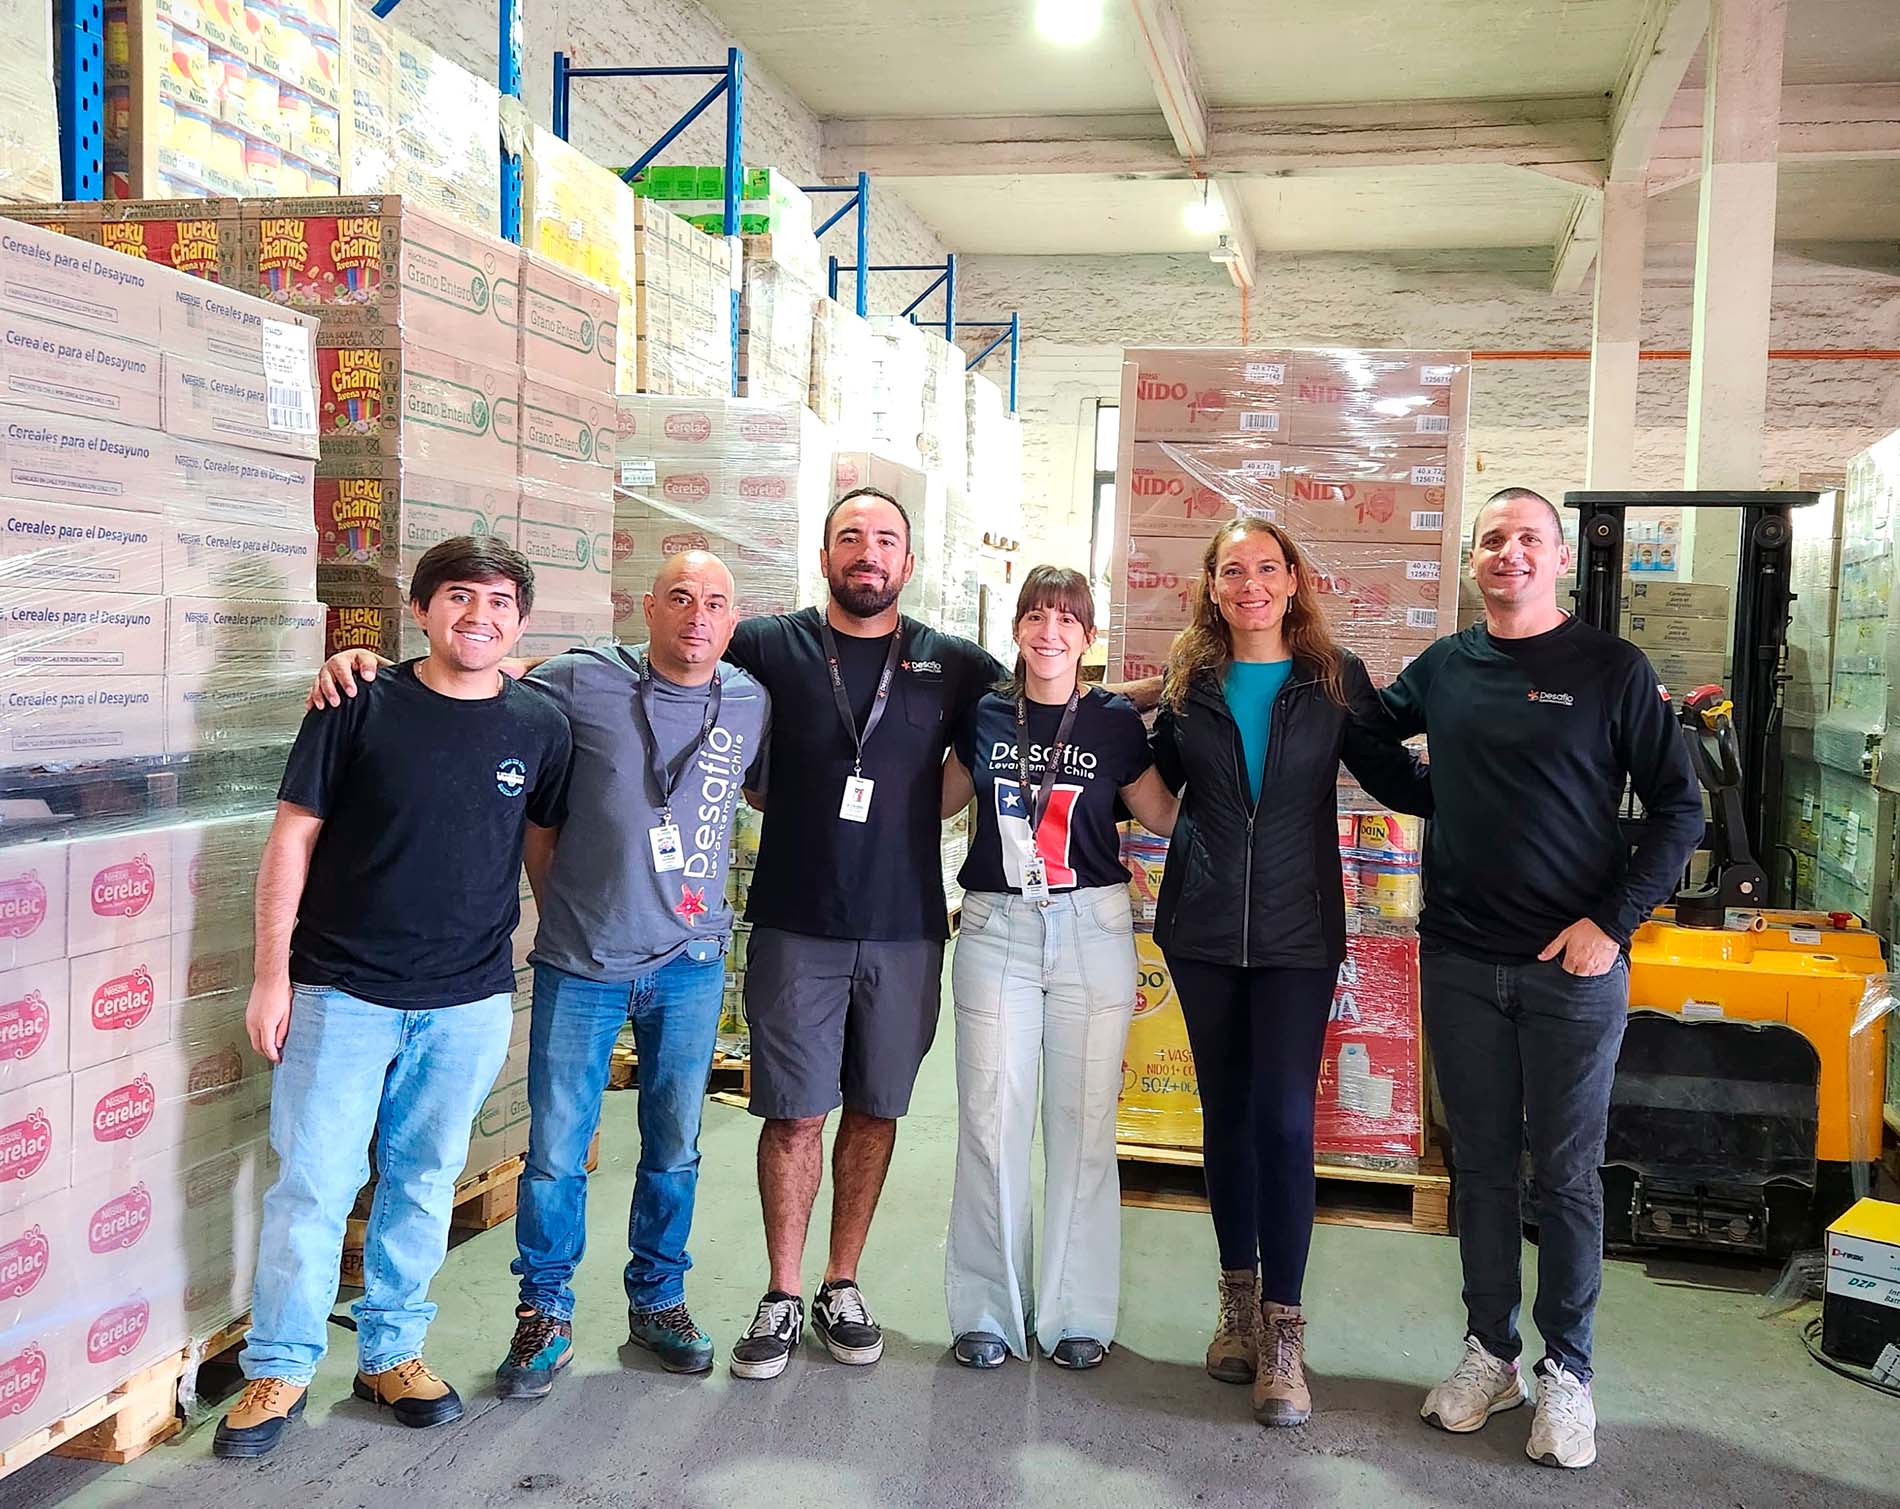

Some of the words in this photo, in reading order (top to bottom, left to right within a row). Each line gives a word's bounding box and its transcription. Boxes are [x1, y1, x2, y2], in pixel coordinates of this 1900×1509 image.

[2, 236, 51, 261] Cereales
[54, 253, 79, 269] para
[82, 259, 92, 273] el
[94, 262, 145, 287] Desayuno
[113, 242, 149, 260] arms
[171, 240, 218, 265] Charm
[331, 239, 381, 262] Charm
[408, 264, 439, 289] Grano
[441, 276, 471, 301] Entero
[205, 299, 241, 321] Cereales
[243, 312, 262, 326] para
[531, 311, 556, 334] Grano
[556, 321, 581, 343] Entero
[6, 330, 55, 353] Cereales
[58, 344, 82, 359] para
[85, 349, 95, 362] el
[97, 351, 146, 373] Desayuno
[210, 379, 245, 398] Cereales
[246, 390, 265, 402] para
[331, 369, 381, 393] Charm
[1137, 381, 1188, 400] NIDO
[408, 395, 439, 417] Grano
[441, 403, 471, 425] Entero
[666, 420, 707, 432] Cerelac
[8, 424, 58, 444] Cereales
[61, 436, 85, 449] para
[88, 438, 98, 450] el
[99, 439, 150, 458] Desayuno
[529, 427, 552, 445] Grano
[554, 433, 578, 452] Entero
[203, 459, 239, 475] Cereales
[665, 483, 706, 495] Cerelac
[1132, 476, 1184, 496] NIDO
[332, 499, 381, 522] Charm
[7, 517, 56, 535] Cereales
[59, 526, 83, 539] para
[86, 525, 96, 539] el
[97, 527, 148, 545] Desayuno
[205, 535, 241, 550] Cereales
[408, 523, 438, 541] Grano
[11, 607, 60, 622] Cereales
[63, 612, 87, 627] para
[101, 611, 151, 628] Desayuno
[213, 612, 249, 625] Cereales
[332, 627, 381, 650] Charm
[1124, 662, 1163, 680] NID
[9, 691, 57, 706] Cereales
[60, 695, 85, 708] para
[87, 691, 97, 705] el
[99, 691, 149, 707] Desayuno
[1064, 765, 1095, 779] Chile
[706, 781, 739, 879] Levantemos
[731, 733, 744, 774] Chile
[1149, 873, 1162, 884] NI
[94, 880, 150, 903] Cerelac
[0, 898, 40, 918] relac
[1137, 971, 1164, 987] DO
[94, 990, 149, 1018] Cerelac
[0, 1016, 44, 1042] relac
[1147, 1064, 1169, 1075] NIDO
[96, 1099, 150, 1130] Cerelac
[0, 1135, 46, 1165] relac
[91, 1206, 146, 1243] Cerelac
[0, 1251, 43, 1282] relac
[1848, 1277, 1877, 1289] DZP
[89, 1312, 145, 1351] Cerelac
[0, 1367, 40, 1397] relac
